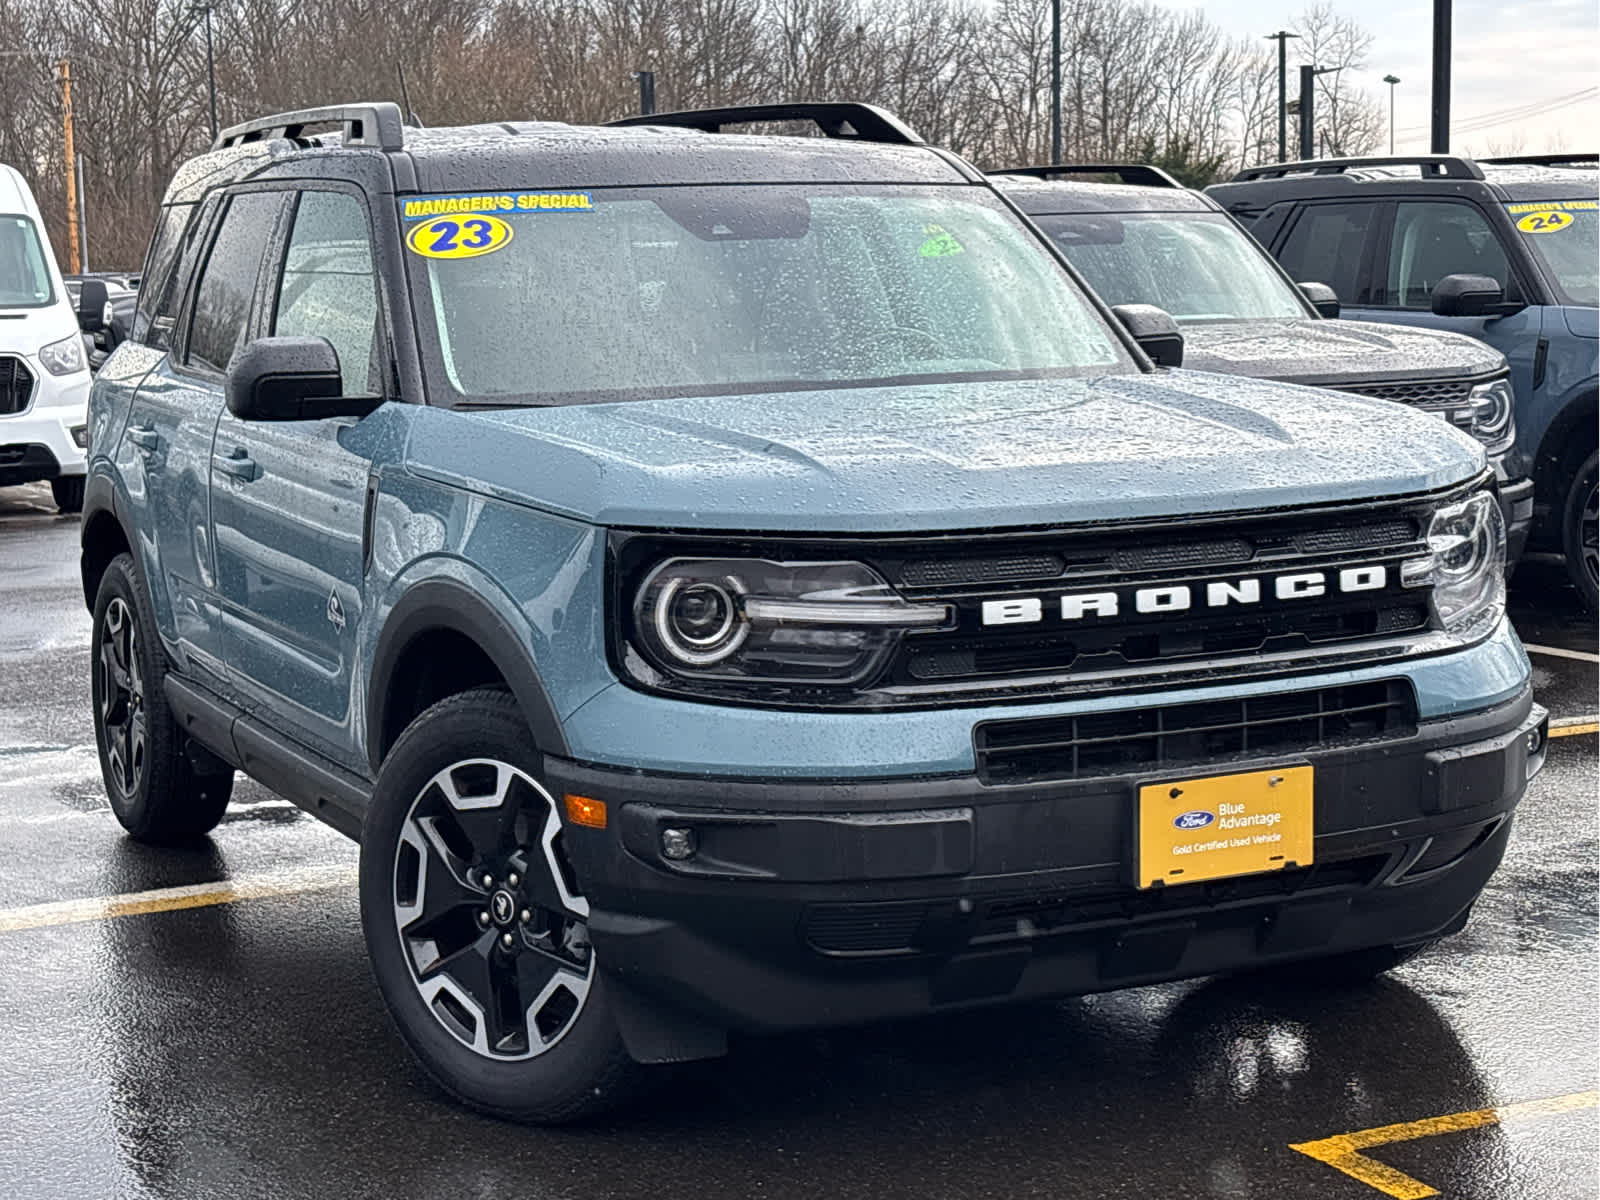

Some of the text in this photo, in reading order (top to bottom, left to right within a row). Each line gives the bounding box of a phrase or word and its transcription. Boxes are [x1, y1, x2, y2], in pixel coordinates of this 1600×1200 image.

[404, 194, 593, 217] MANAGER'S SPECIAL
[1530, 213, 1563, 230] 24
[429, 219, 493, 252] 23
[982, 566, 1386, 625] BRONCO
[1218, 803, 1245, 816] Blue
[1179, 811, 1213, 829] Ford
[1218, 812, 1281, 830] Advantage
[1172, 833, 1282, 856] Gold Certified Used Vehicle
